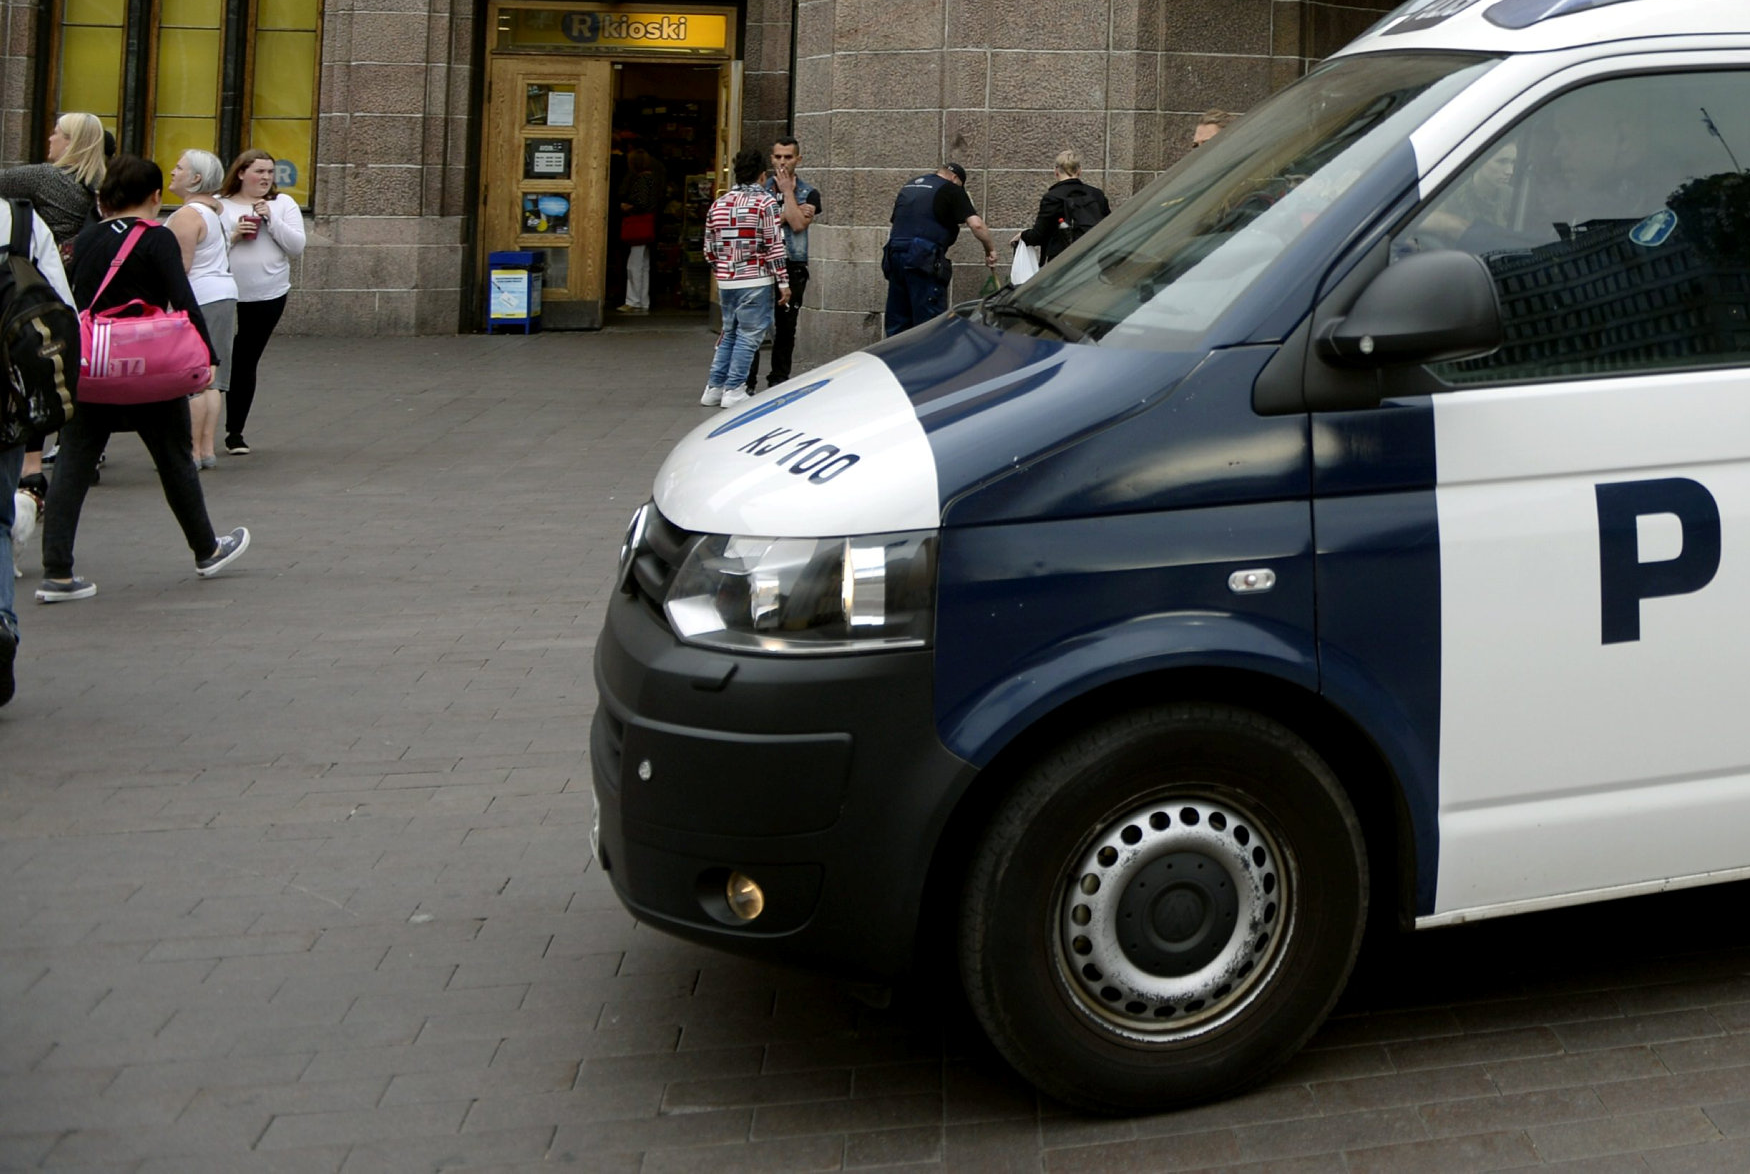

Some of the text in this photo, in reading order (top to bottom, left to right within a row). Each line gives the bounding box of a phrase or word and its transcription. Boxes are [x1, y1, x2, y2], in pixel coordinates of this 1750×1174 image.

[603, 15, 687, 40] kioski
[737, 427, 861, 485] KJ 100
